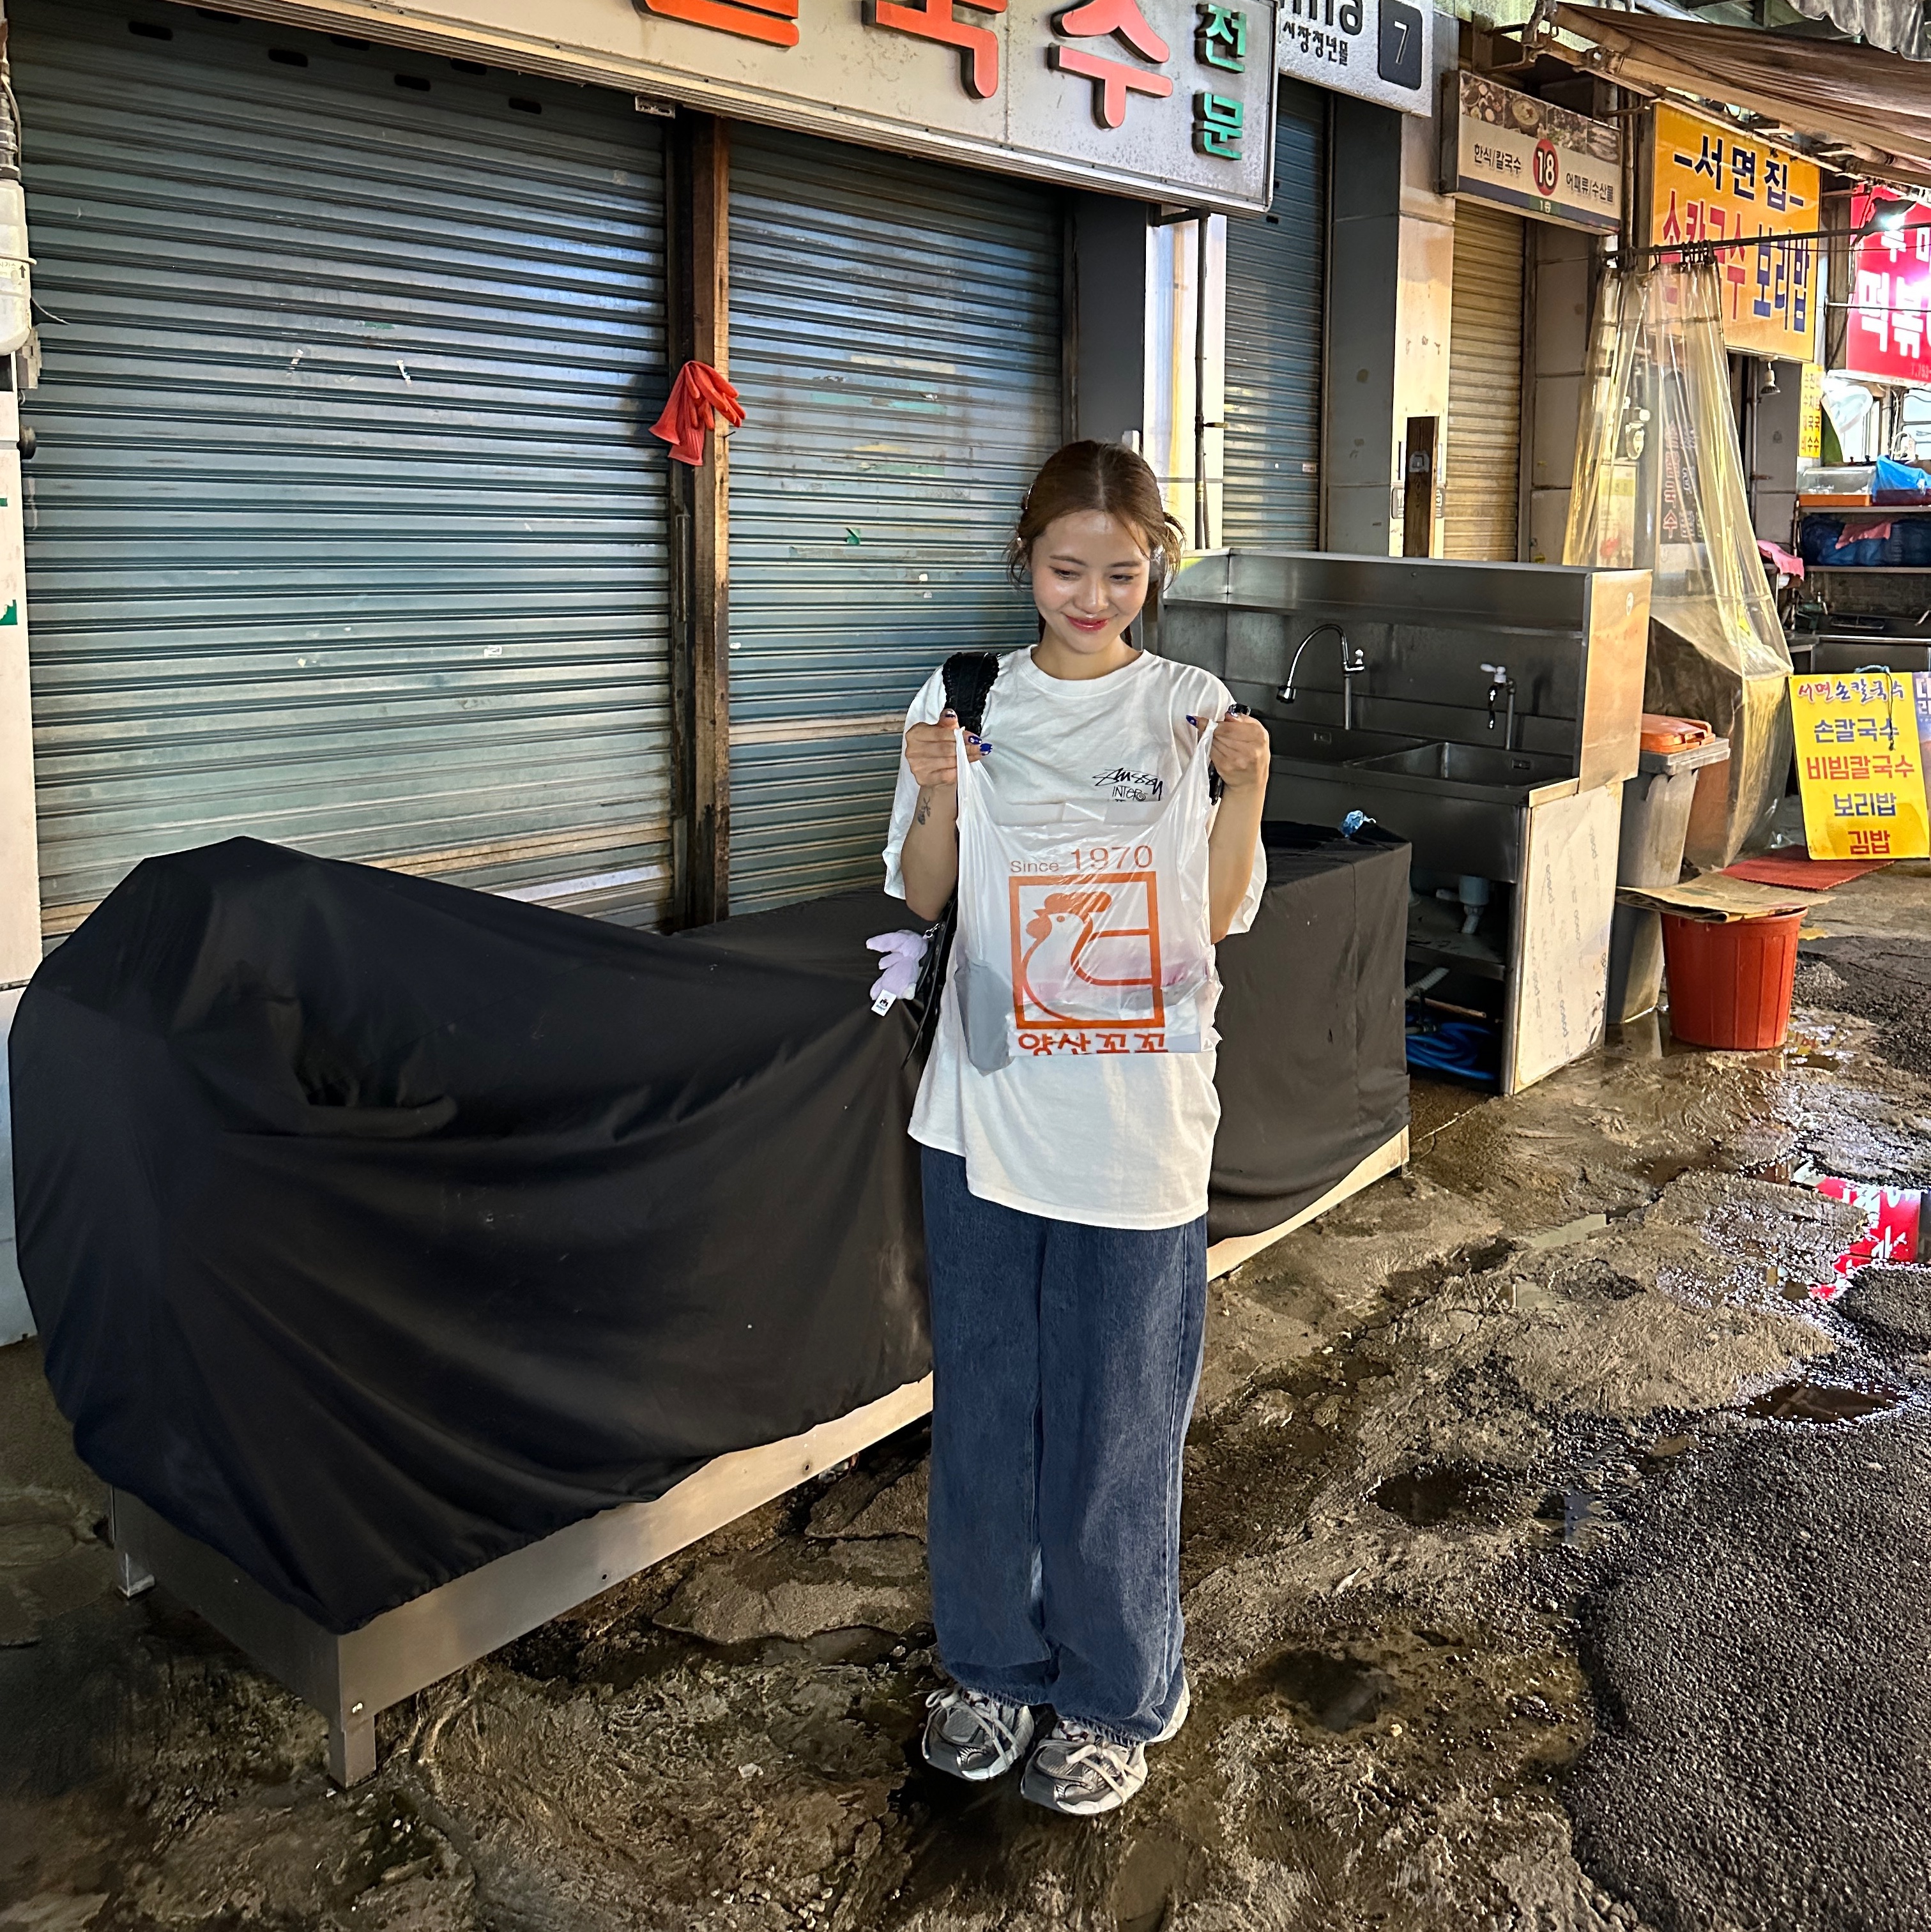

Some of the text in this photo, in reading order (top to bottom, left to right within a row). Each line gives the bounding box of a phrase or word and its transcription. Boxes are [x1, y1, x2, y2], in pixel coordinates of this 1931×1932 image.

[1394, 21, 1409, 65] 7
[1198, 3, 1247, 160] 전문
[1474, 143, 1522, 175] 한식/칼국수
[1535, 148, 1556, 191] 18
[1814, 718, 1900, 743] 손칼국수
[1806, 755, 1915, 779] 비빔칼국수
[1834, 793, 1897, 816] 보리밥
[1847, 830, 1890, 855] 김밥
[1011, 845, 1153, 872] Since 1970
